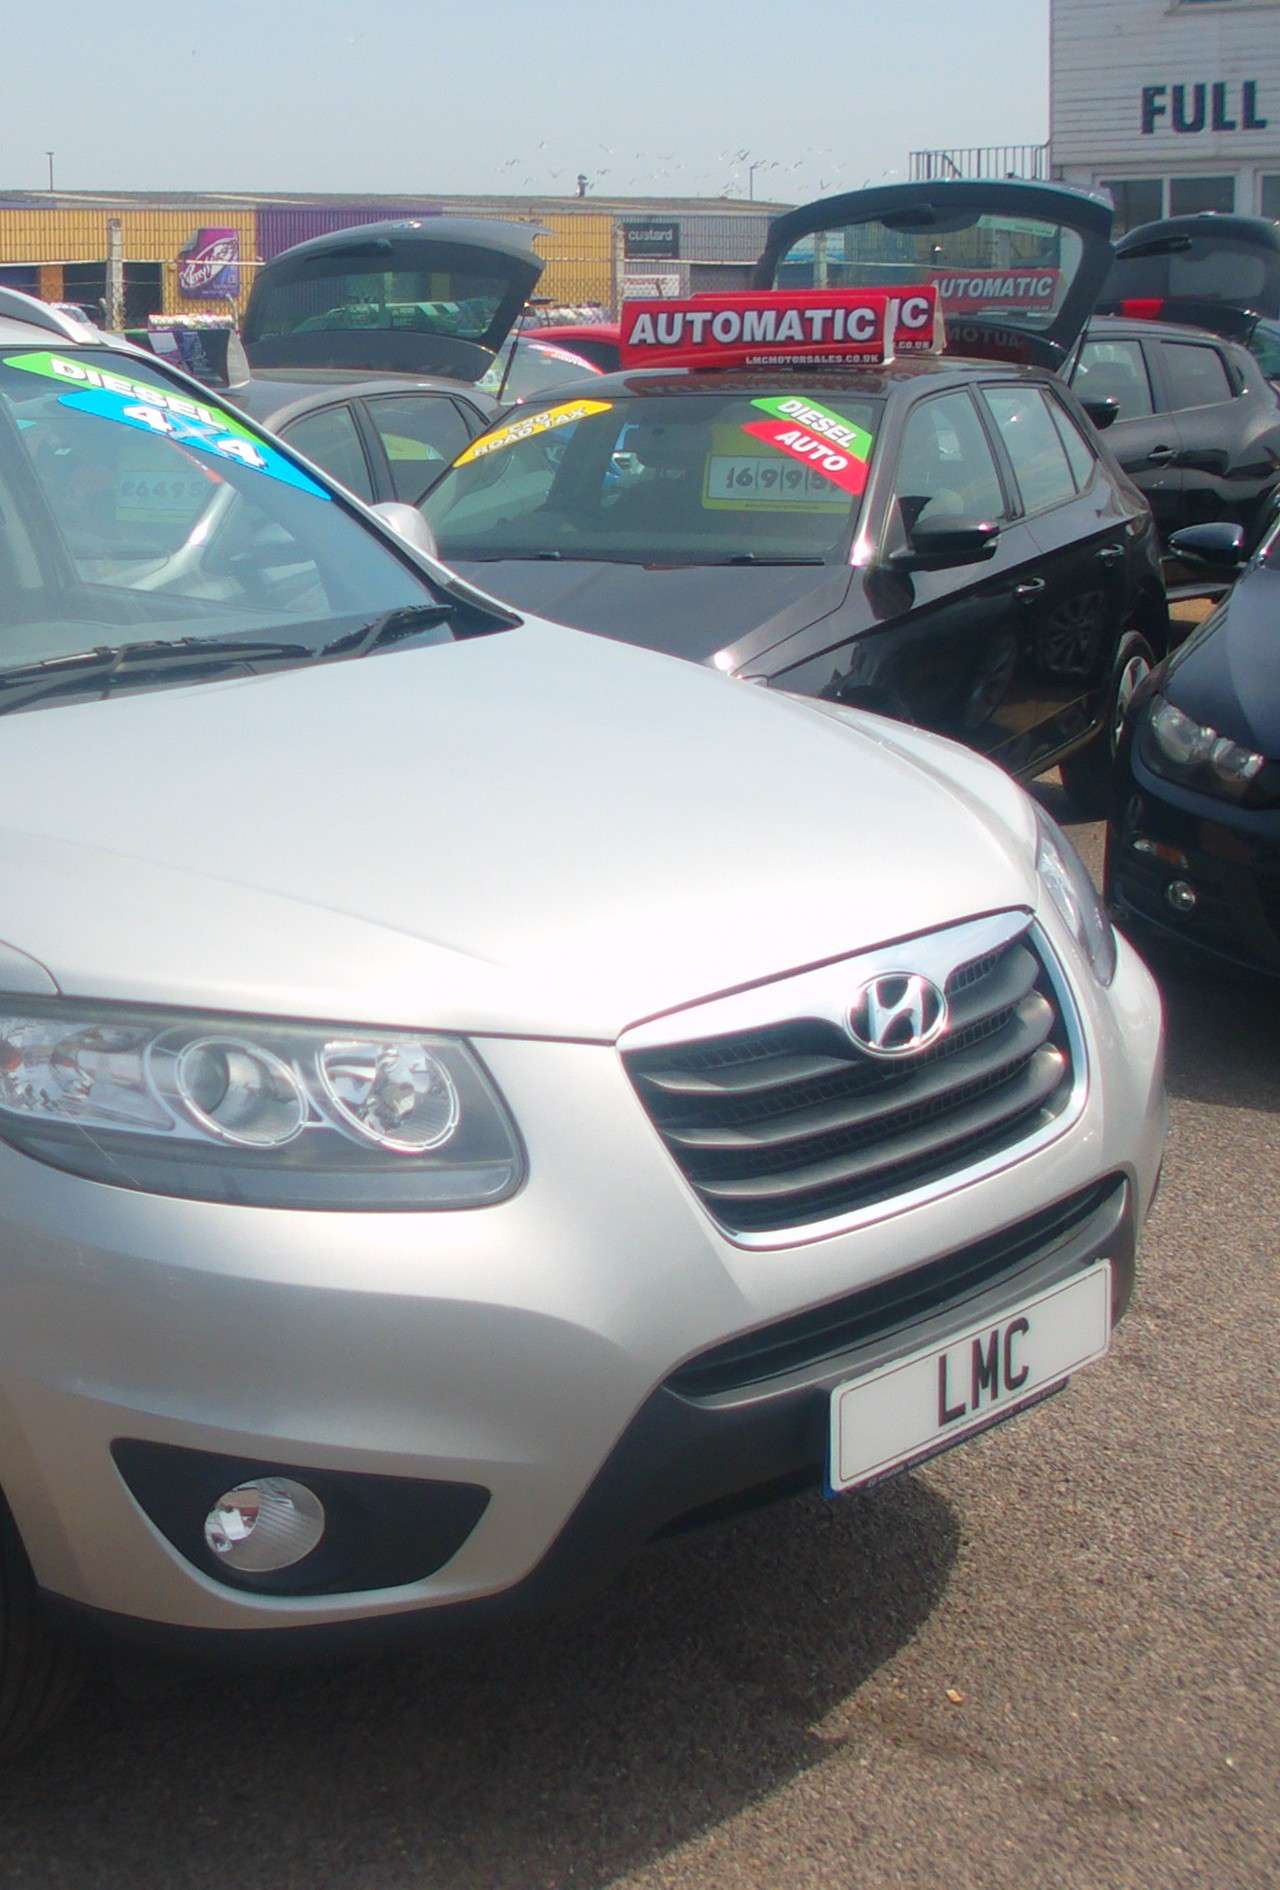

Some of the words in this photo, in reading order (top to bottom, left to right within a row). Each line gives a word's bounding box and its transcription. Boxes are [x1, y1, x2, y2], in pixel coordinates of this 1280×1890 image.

[1140, 80, 1268, 135] FULL
[628, 307, 876, 345] AUTOMATIC
[50, 357, 229, 432] DIESEL
[545, 407, 588, 429] TAX
[777, 399, 857, 448] DIESEL
[774, 430, 849, 471] AUTO
[938, 1316, 1030, 1428] LMC
